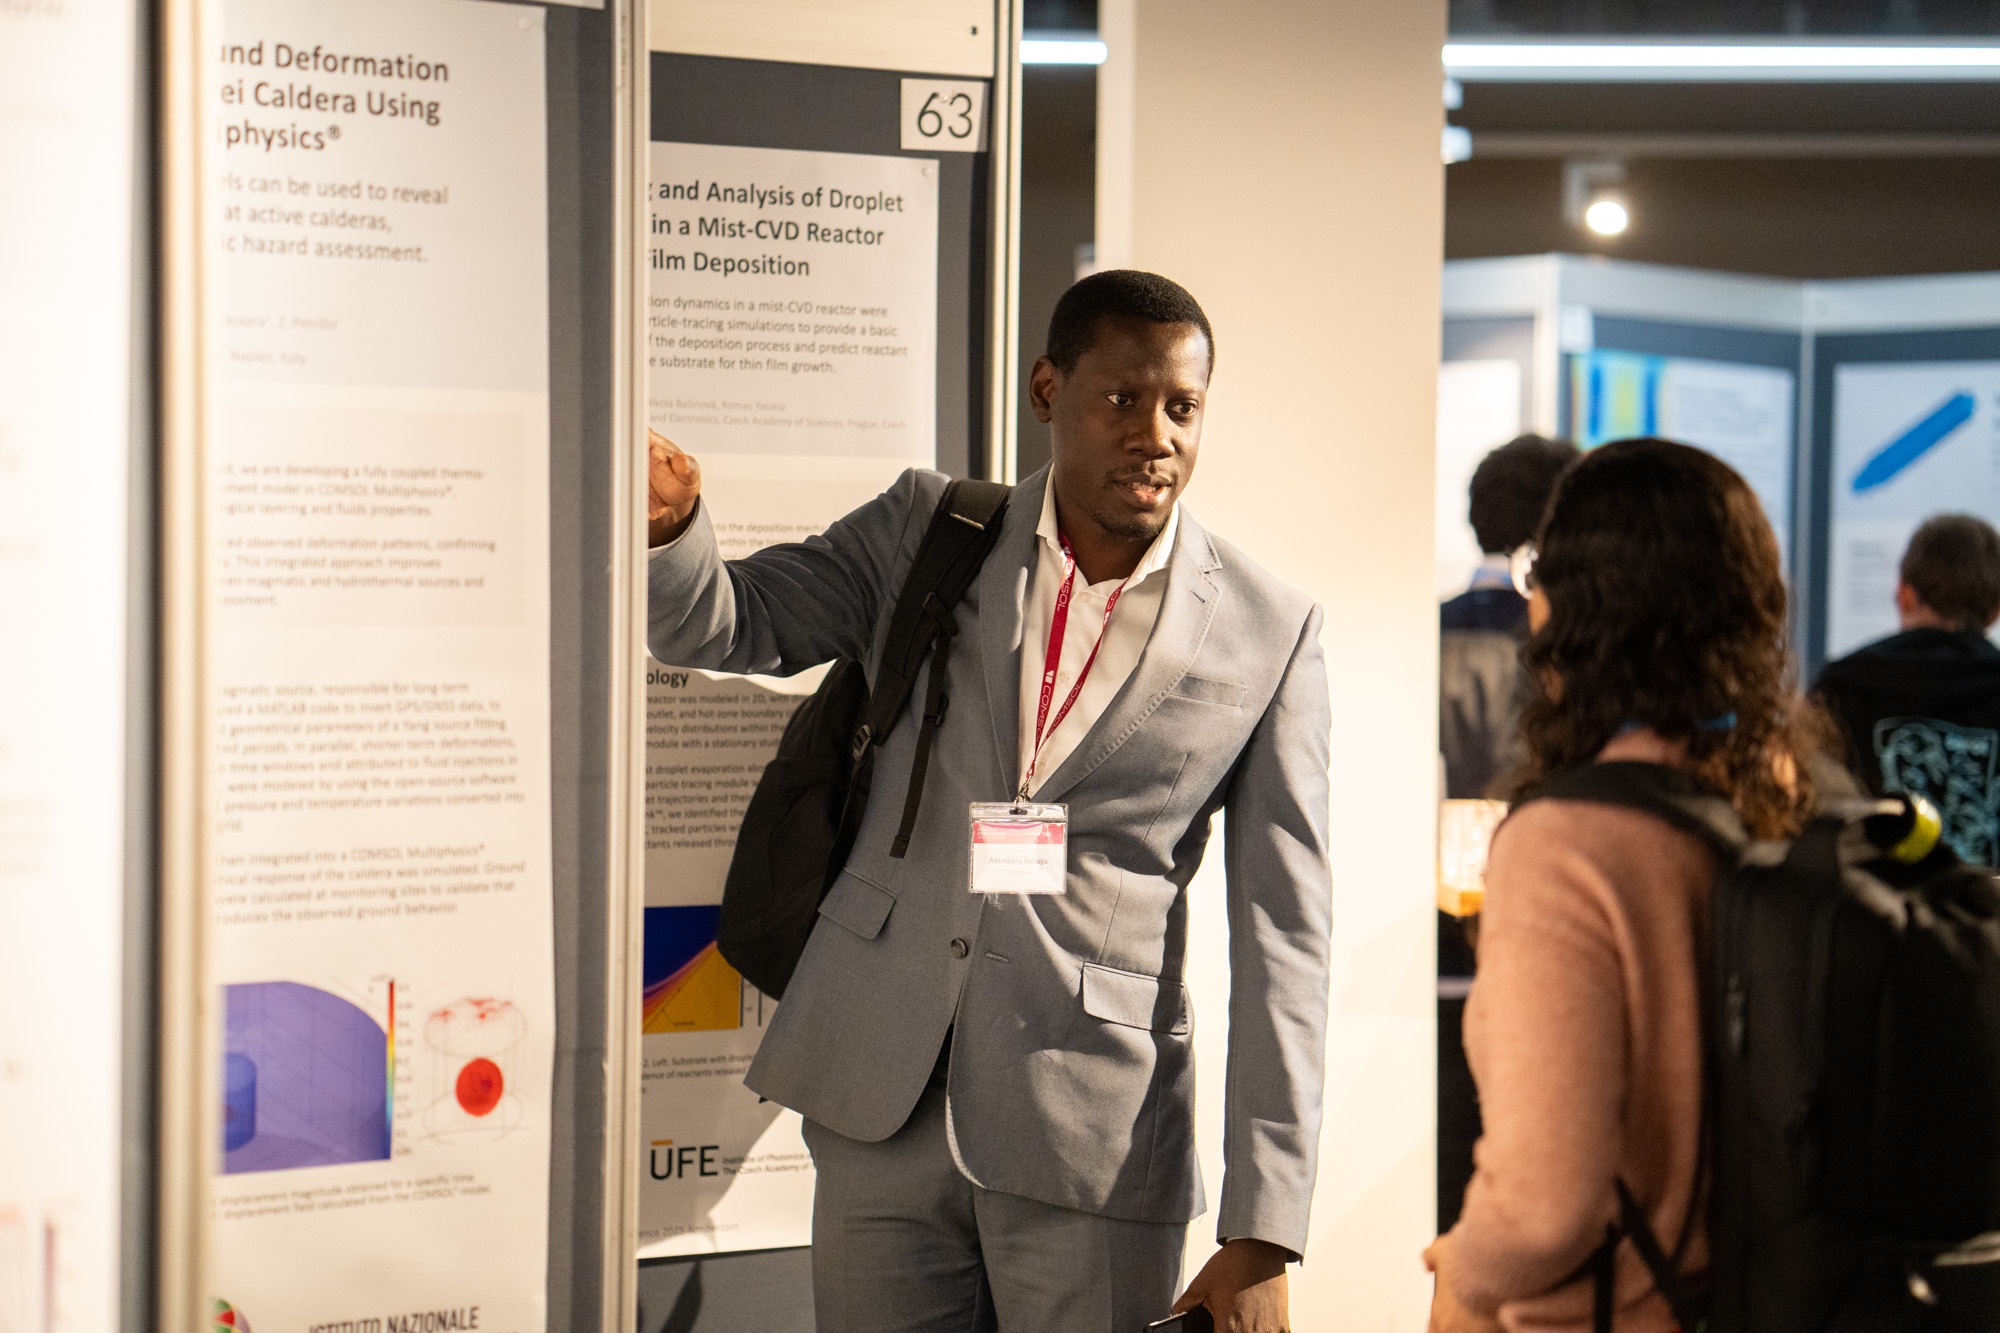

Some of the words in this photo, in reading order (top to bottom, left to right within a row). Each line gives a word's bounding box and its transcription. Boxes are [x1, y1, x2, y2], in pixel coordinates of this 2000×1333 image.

[274, 43, 450, 83] Deformation
[254, 82, 356, 114] Caldera
[366, 91, 441, 126] Using
[917, 92, 973, 139] 63
[248, 177, 281, 193] can
[287, 176, 310, 196] be
[316, 180, 361, 199] used
[368, 184, 388, 201] to
[392, 187, 449, 206] reveal
[659, 180, 699, 201] and
[706, 183, 795, 209] Analysis
[802, 187, 825, 207] of
[829, 190, 905, 214] Droplet
[223, 206, 242, 221] at
[247, 206, 304, 226] active
[309, 210, 393, 233] calderas,
[652, 214, 671, 235] in
[678, 222, 690, 236] a
[698, 217, 800, 241] Mist-CVD
[806, 223, 884, 246] Reactor
[242, 235, 309, 256] hazard
[314, 242, 430, 263] assessment.
[693, 252, 811, 278] Deposition
[673, 297, 730, 311] dynamics
[734, 298, 745, 311] in
[748, 302, 755, 312] a
[758, 301, 813, 315] mist-CVD
[816, 304, 857, 316] reactor
[859, 307, 888, 317] were
[727, 319, 795, 333] simulations
[798, 322, 811, 333] to
[813, 323, 857, 338] provide
[860, 327, 866, 336] a
[869, 324, 898, 337] basic
[655, 334, 675, 348] the
[679, 336, 743, 353] deposition
[746, 342, 790, 354] process
[793, 340, 816, 353] and
[819, 342, 859, 357] predict
[862, 345, 908, 357] reactant
[659, 356, 716, 369] substrate
[719, 357, 735, 370] for
[738, 358, 763, 371] thin
[765, 359, 789, 372] film
[791, 361, 836, 376] growth.
[729, 523, 743, 532] the
[745, 523, 794, 533] deposition
[647, 669, 689, 688] ology
[679, 695, 697, 704] was
[700, 694, 739, 704] modeled
[741, 694, 750, 704] in
[679, 710, 696, 719] and
[699, 709, 739, 719] hot-zone
[741, 709, 784, 721] boundary
[681, 723, 738, 734] distributions
[740, 722, 768, 733] within
[682, 739, 701, 748] with
[712, 739, 757, 750] stationary
[655, 765, 689, 776] droplet
[691, 765, 745, 776] evaporation
[681, 780, 713, 790] tracing
[714, 778, 749, 788] module
[657, 795, 709, 807] trajectories
[712, 794, 728, 804] and
[684, 808, 728, 819] identified
[652, 825, 686, 835] tracked
[687, 824, 727, 836] particles
[673, 838, 712, 849] released
[386, 1305, 480, 1333] NAZIONALE
